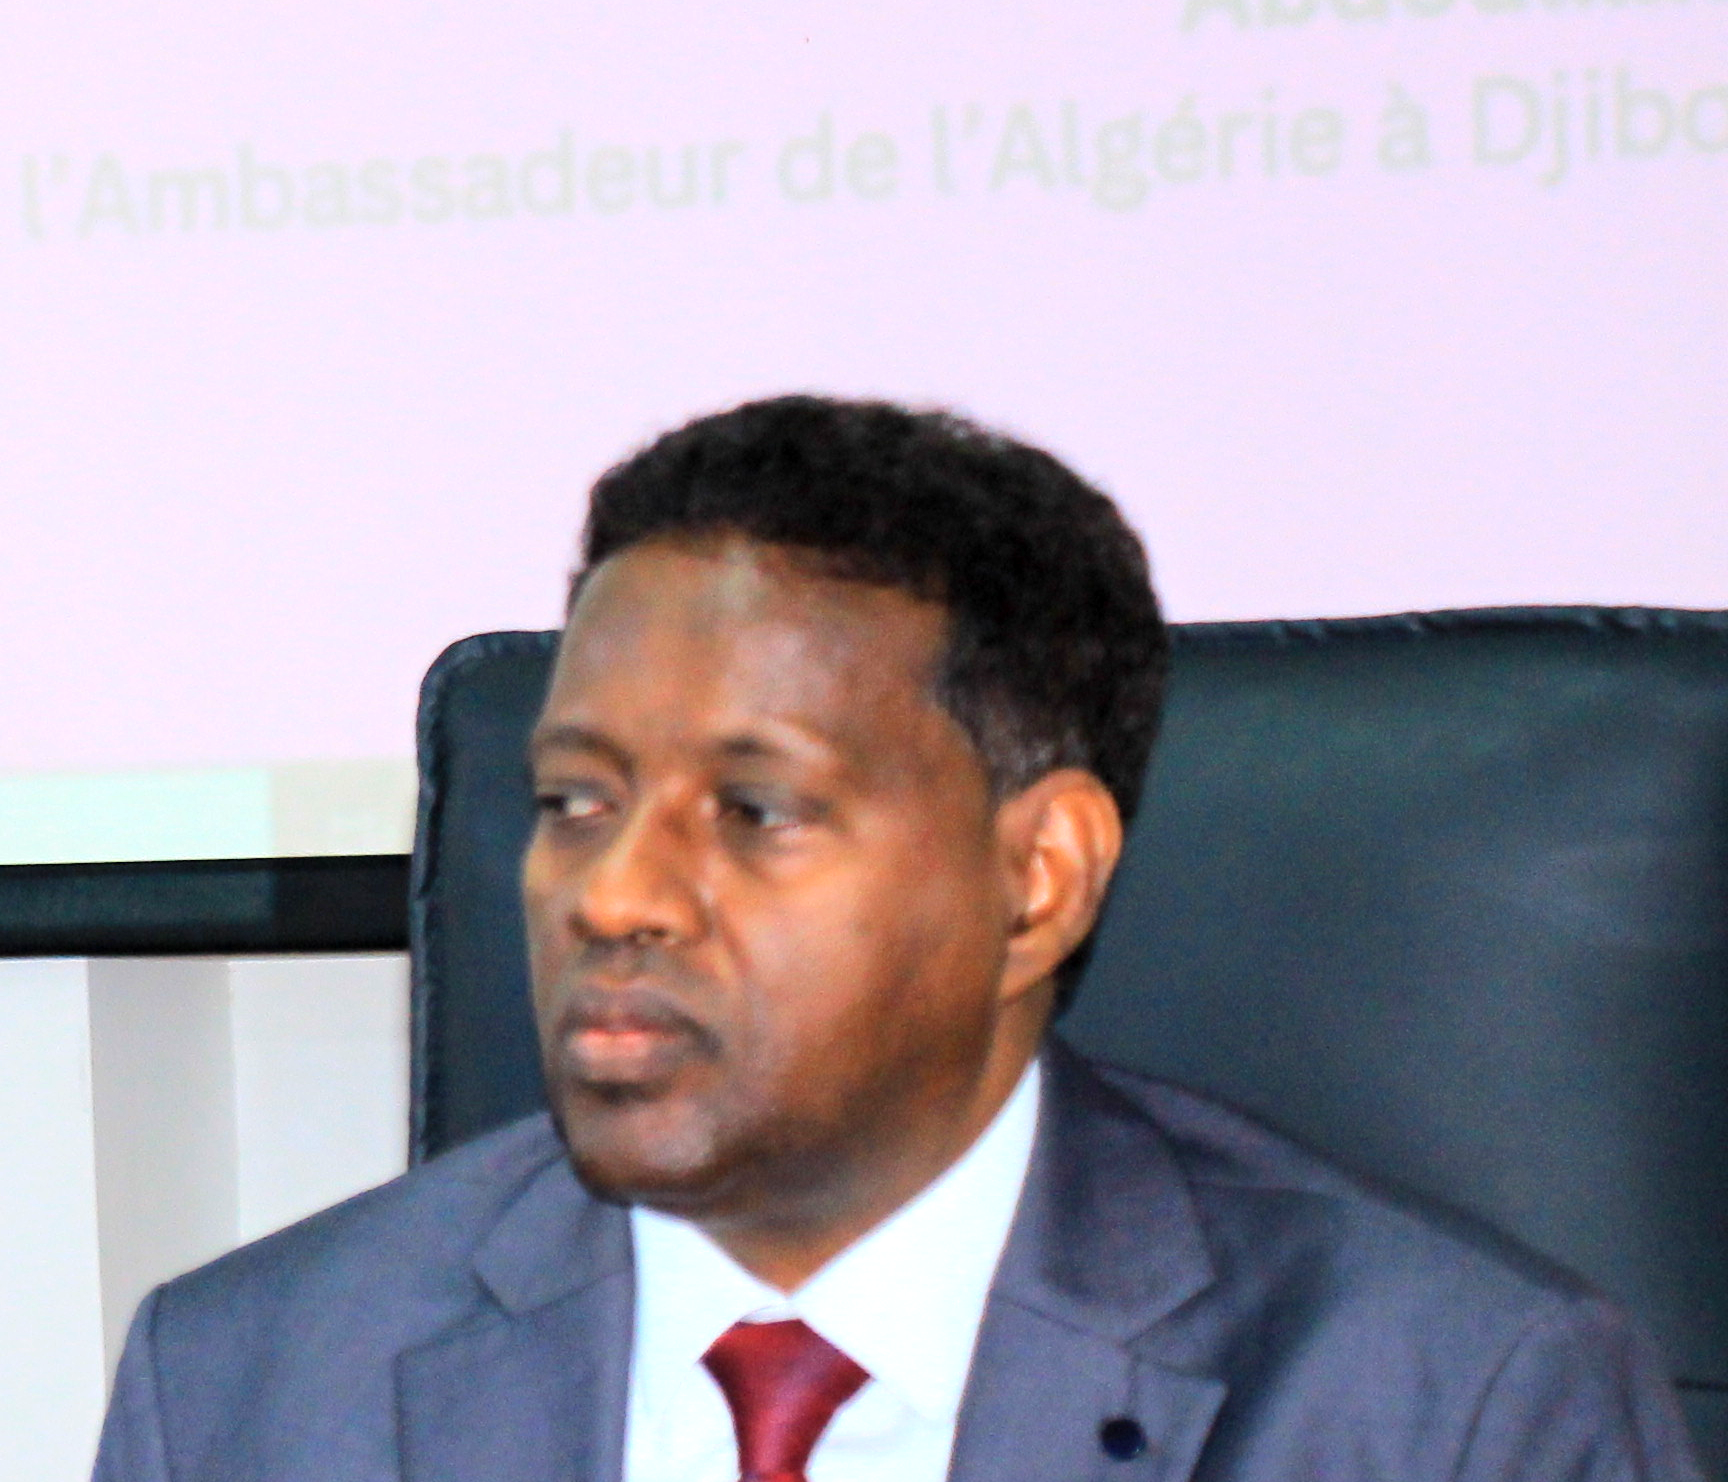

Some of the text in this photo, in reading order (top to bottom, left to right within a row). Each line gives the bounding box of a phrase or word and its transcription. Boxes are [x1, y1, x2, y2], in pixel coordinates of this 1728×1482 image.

[774, 109, 901, 203] de
[1374, 80, 1433, 173] à
[1470, 58, 1728, 191] Djibo
